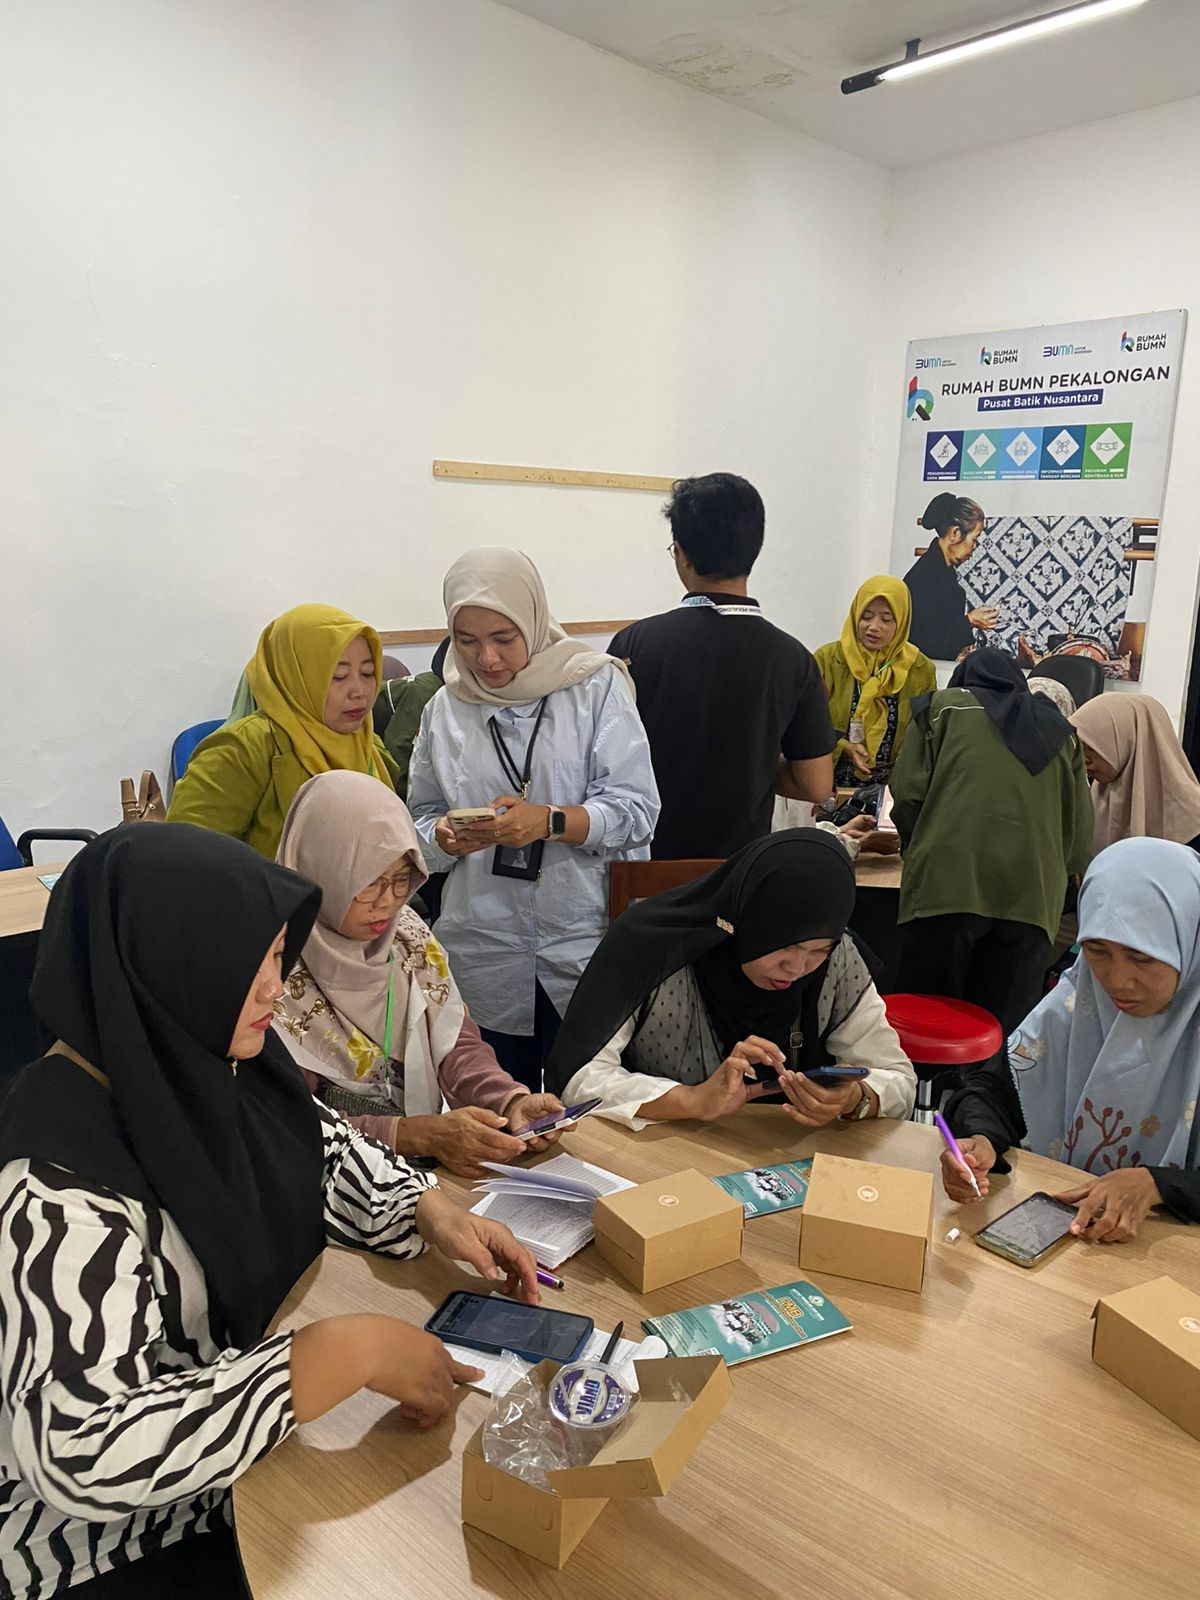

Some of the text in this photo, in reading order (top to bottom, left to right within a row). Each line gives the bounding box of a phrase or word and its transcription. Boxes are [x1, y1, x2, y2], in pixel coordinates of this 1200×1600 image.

[1136, 333, 1167, 342] RUMAH
[993, 348, 1018, 356] RUMAH
[1043, 344, 1074, 358] BUMN
[1136, 341, 1166, 351] BUMN
[915, 357, 942, 369] BUMN
[993, 355, 1018, 365] BUMN
[941, 365, 1169, 396] RUMAH BUMN PEKALONGAN
[983, 393, 1099, 409] Pusat Batik Nusantara
[575, 1379, 601, 1415] VIAND
